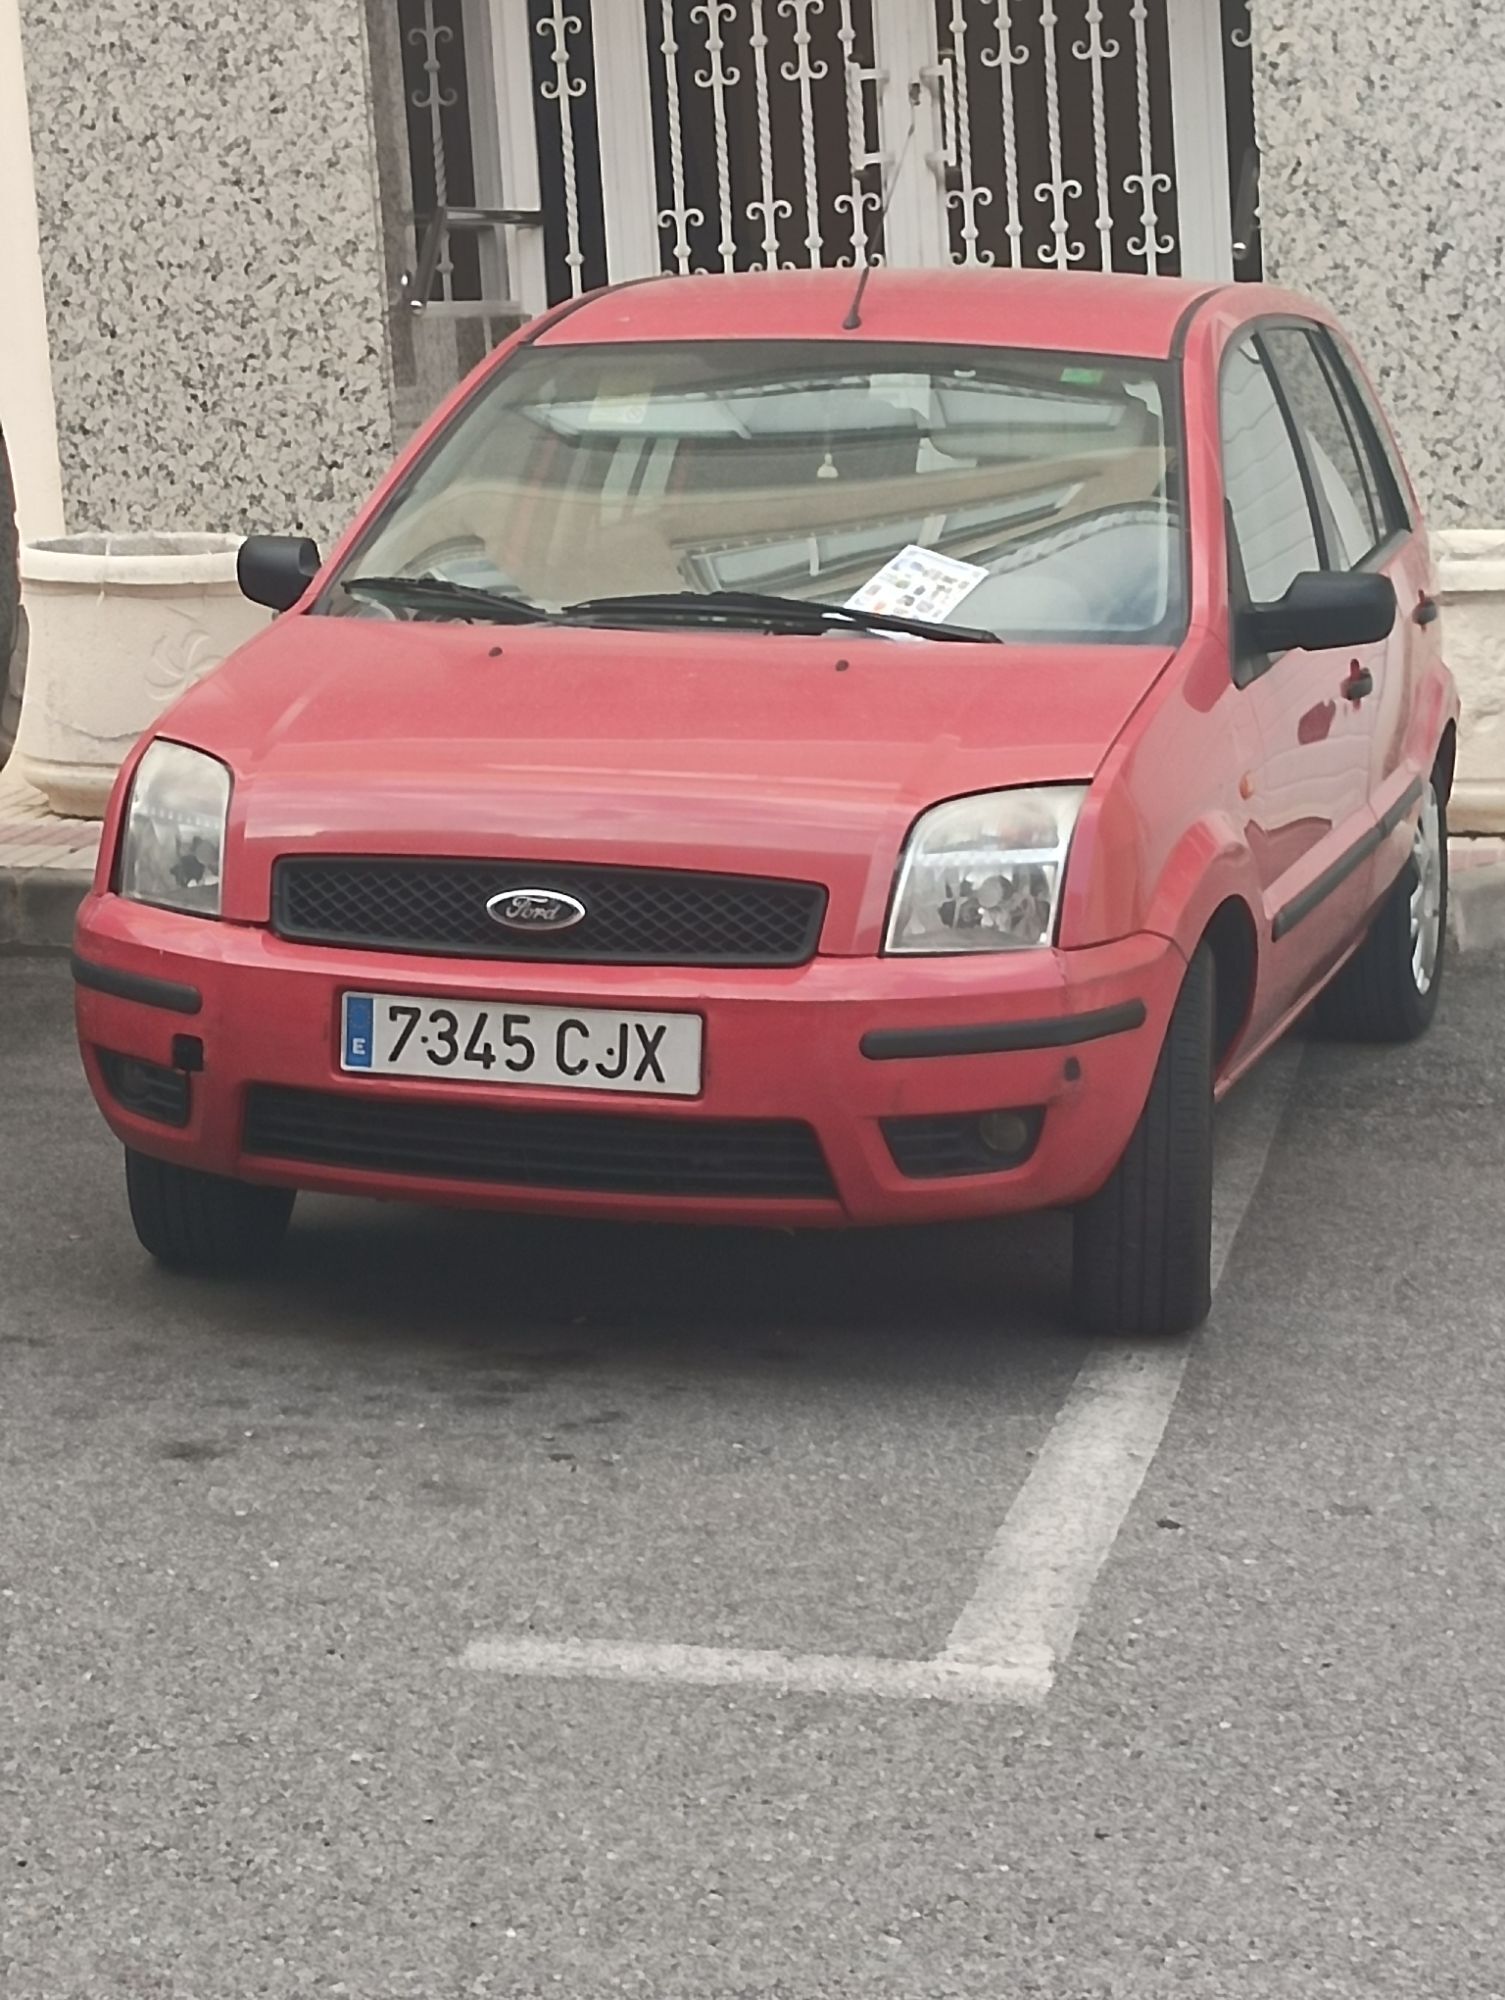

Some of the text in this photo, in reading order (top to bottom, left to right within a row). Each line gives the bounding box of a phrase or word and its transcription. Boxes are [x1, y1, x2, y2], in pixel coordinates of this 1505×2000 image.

[506, 896, 561, 920] Ford
[352, 1038, 366, 1055] E
[388, 1005, 667, 1083] 7345 CJX
